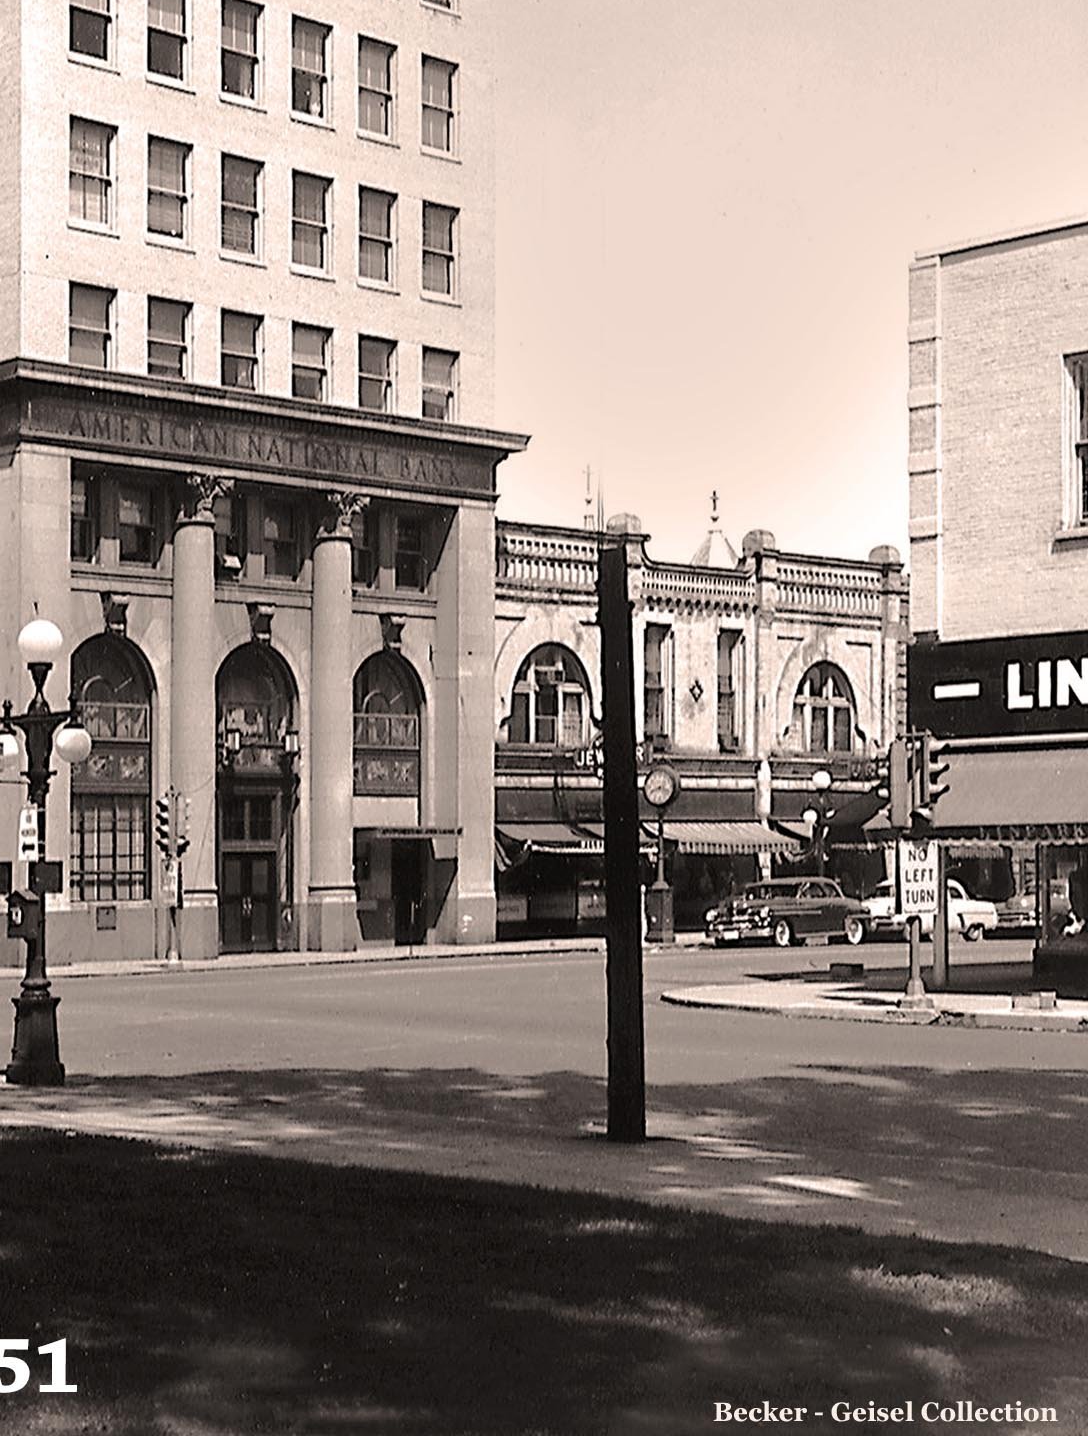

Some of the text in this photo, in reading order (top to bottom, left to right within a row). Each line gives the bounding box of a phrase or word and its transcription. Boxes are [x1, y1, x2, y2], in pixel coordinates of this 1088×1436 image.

[68, 410, 462, 488] AMERICAN NATIONAL BANK
[908, 848, 928, 862] NO
[905, 867, 934, 883] LEFT
[905, 889, 935, 905] TURN
